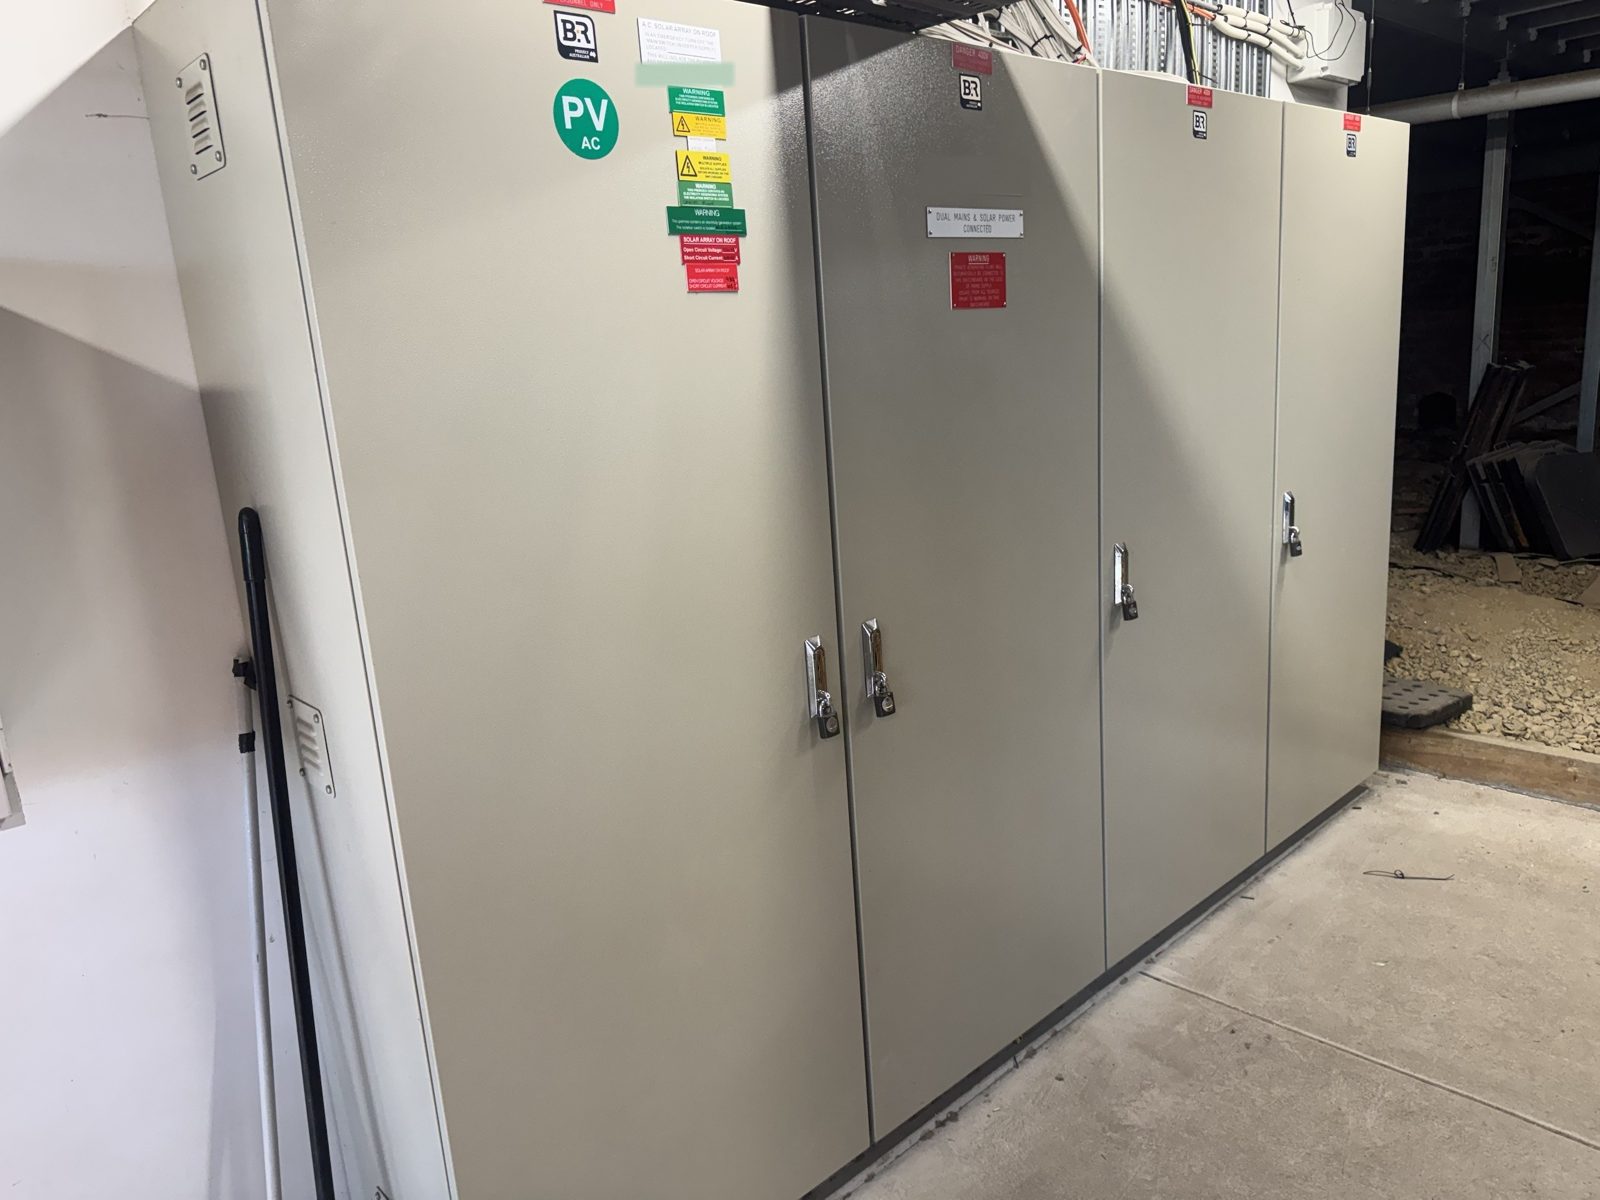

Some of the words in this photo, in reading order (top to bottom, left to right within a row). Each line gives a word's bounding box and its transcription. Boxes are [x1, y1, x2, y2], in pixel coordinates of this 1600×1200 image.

[683, 88, 710, 96] WARNING
[562, 96, 608, 131] PV
[582, 136, 600, 150] AC
[936, 212, 950, 221] DUAL
[954, 213, 970, 221] MAINS
[979, 214, 996, 222] SOLAR
[998, 214, 1016, 222] POWER
[962, 224, 992, 234] CONNECTED
